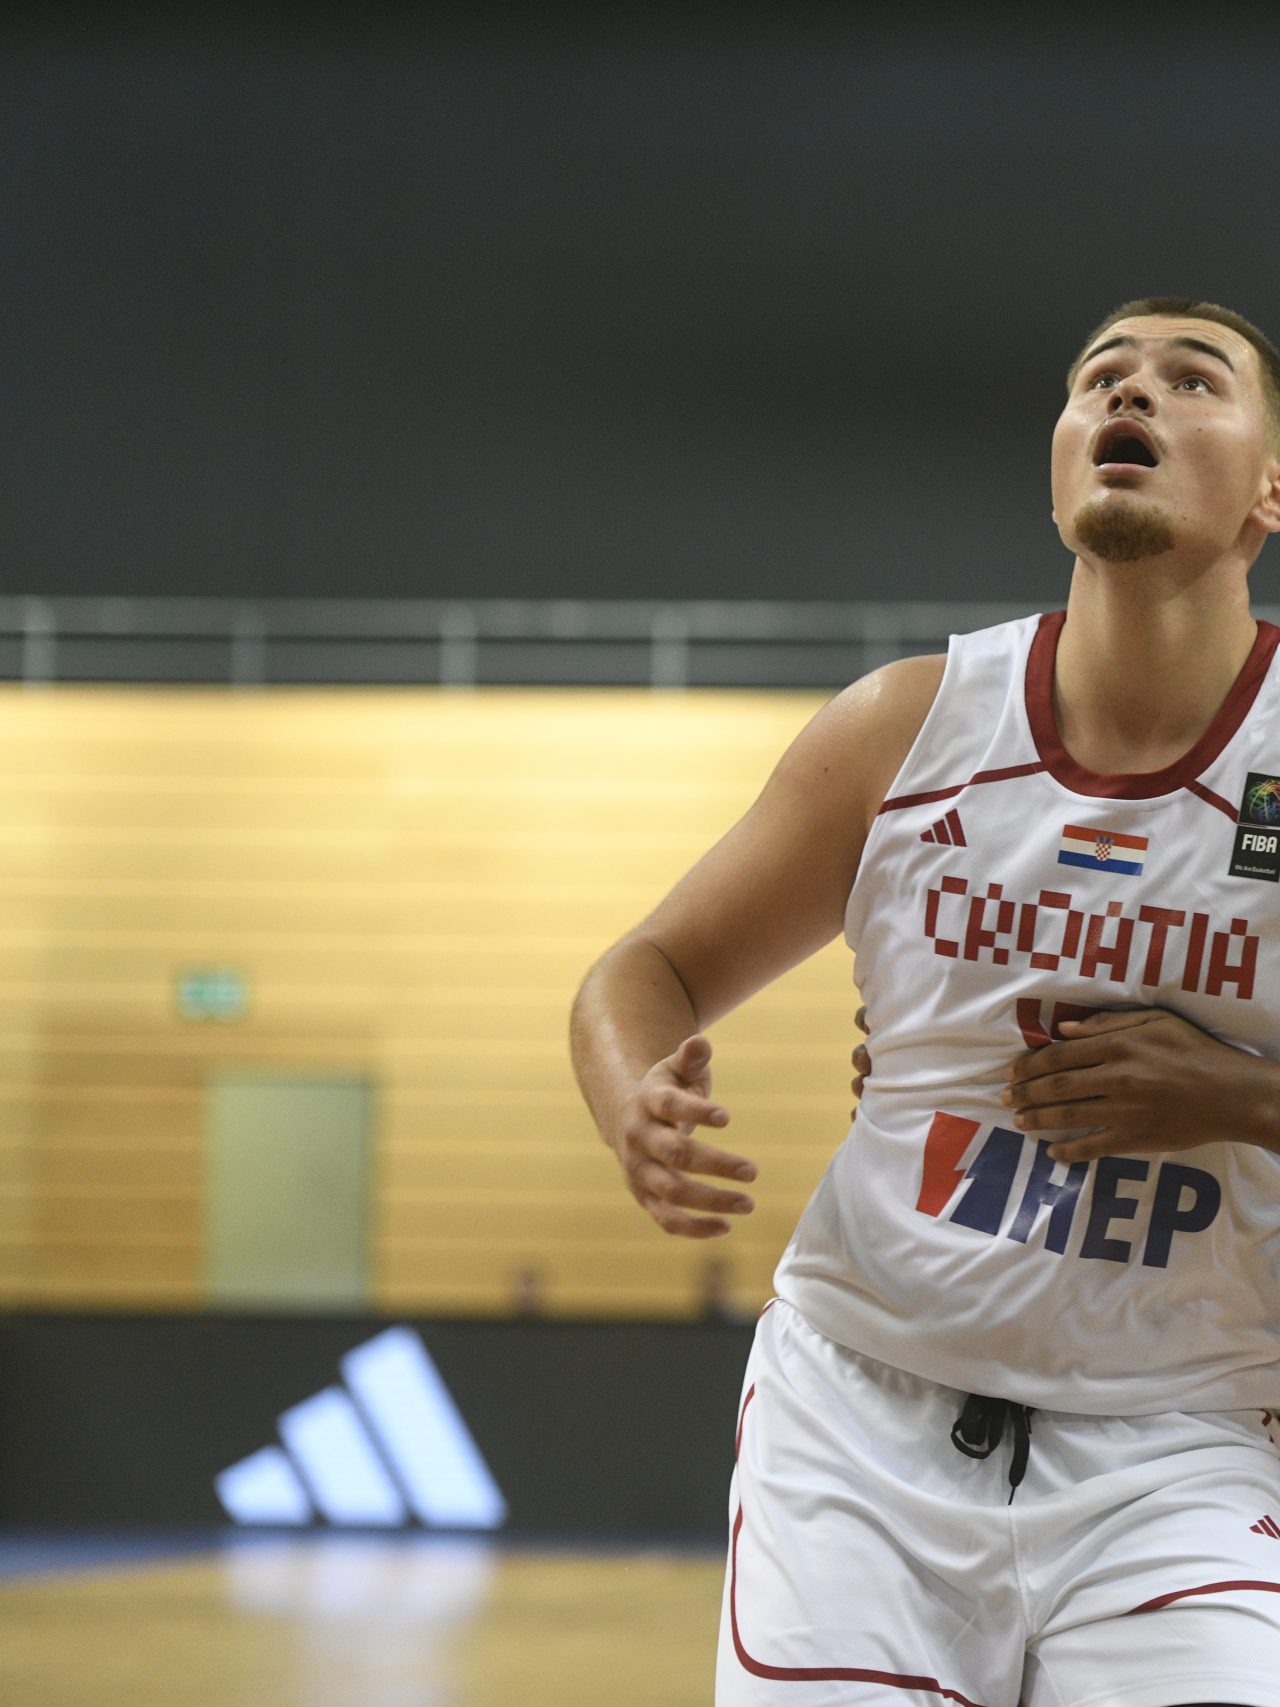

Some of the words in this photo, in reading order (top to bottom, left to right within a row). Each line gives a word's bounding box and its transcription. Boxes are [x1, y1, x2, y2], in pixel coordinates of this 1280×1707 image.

[1241, 833, 1278, 854] FIBA
[924, 875, 1260, 1000] CROATIA
[1006, 1136, 1222, 1269] HEP
